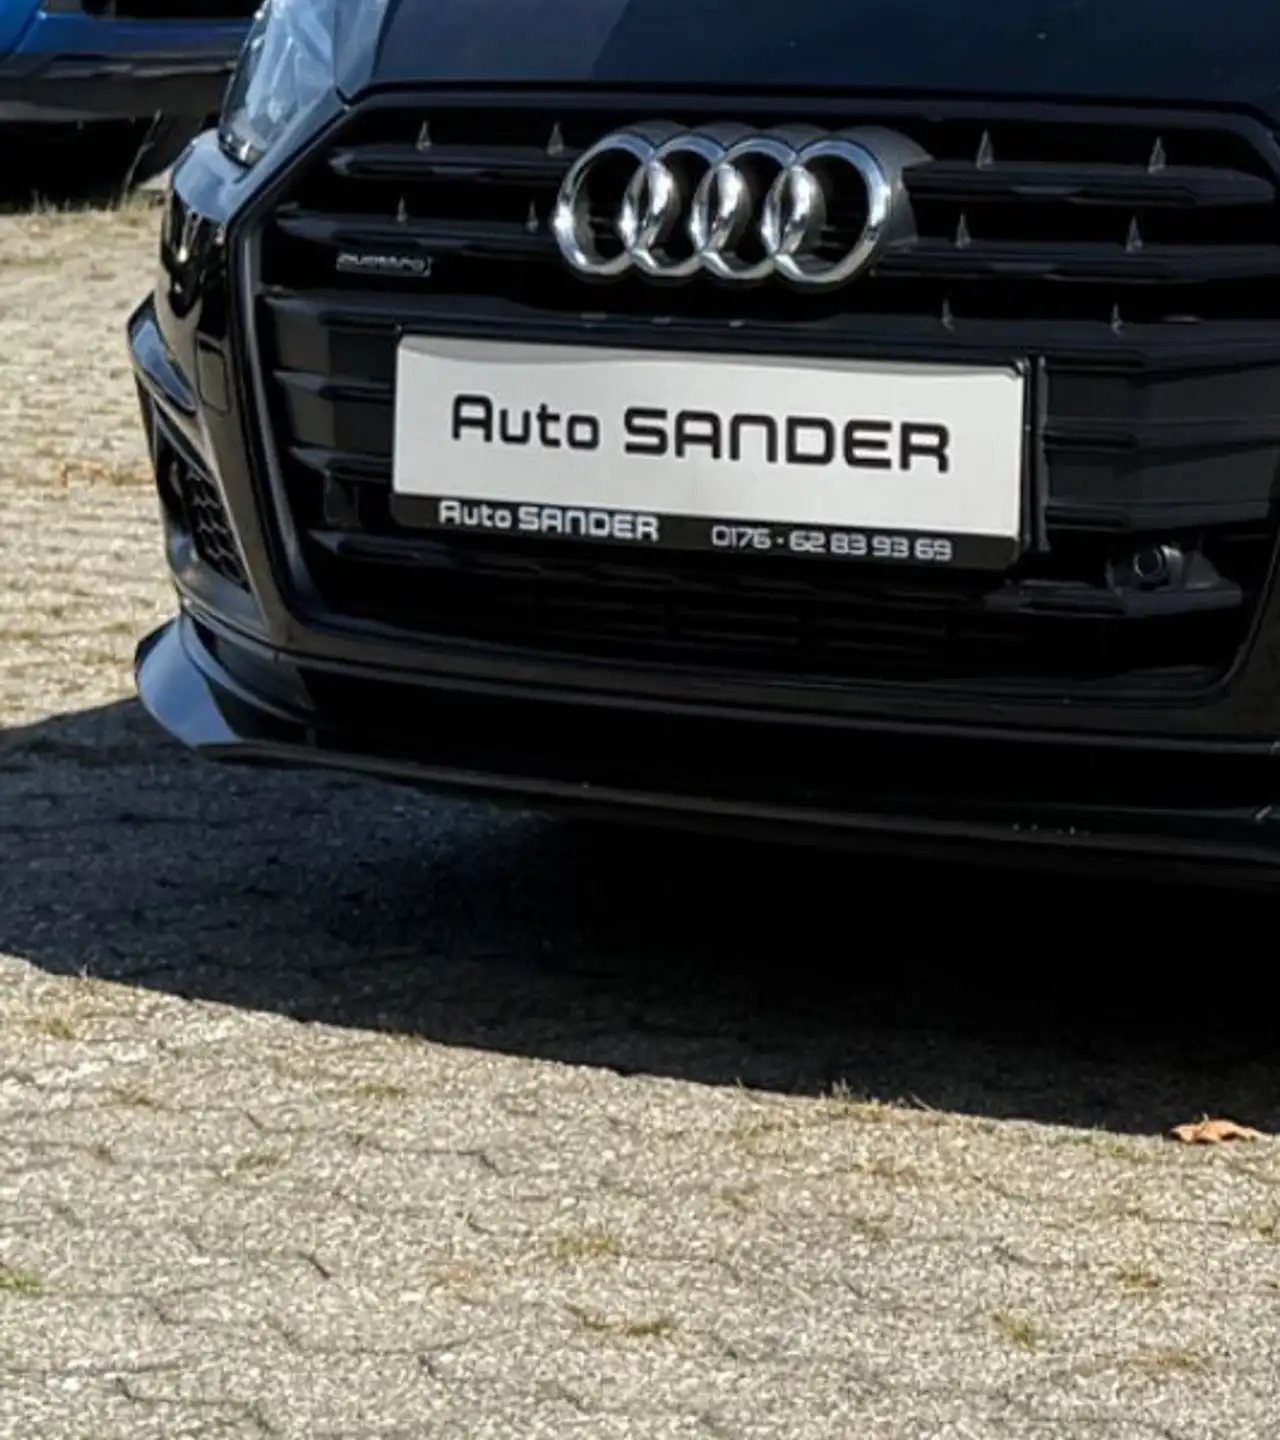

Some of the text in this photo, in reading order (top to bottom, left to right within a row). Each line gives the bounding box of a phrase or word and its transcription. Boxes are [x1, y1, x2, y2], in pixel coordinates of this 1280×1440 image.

[452, 394, 950, 473] Auto SANDER
[438, 500, 660, 542] Auto SANDER
[711, 524, 772, 549] 0176
[789, 530, 827, 554] 62
[830, 532, 868, 556] 83
[871, 534, 910, 559] 93
[914, 537, 952, 561] 69
